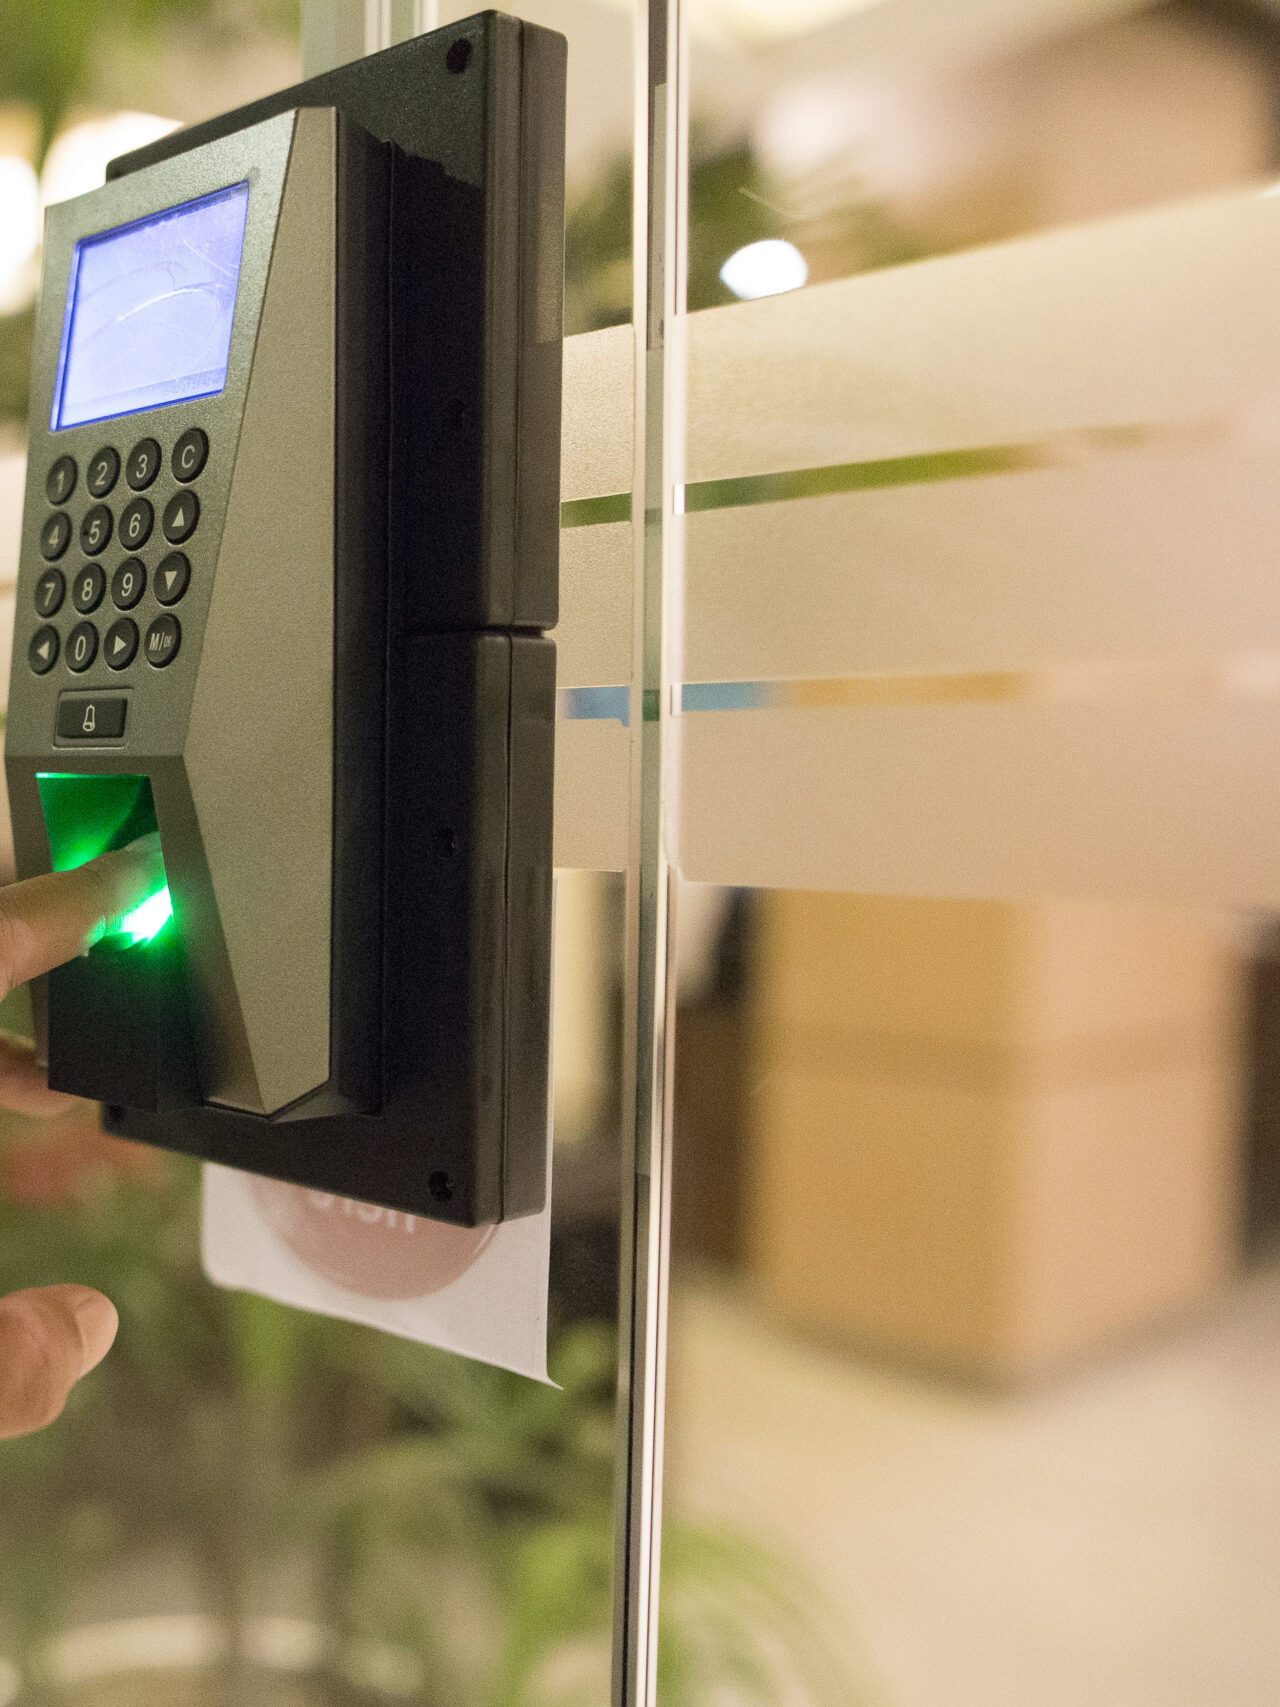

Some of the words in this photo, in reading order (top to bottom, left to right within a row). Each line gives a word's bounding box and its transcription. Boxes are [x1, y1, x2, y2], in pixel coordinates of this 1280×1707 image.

[135, 453, 148, 479] 3
[180, 444, 196, 470] C
[94, 461, 108, 487] 2
[47, 525, 60, 549] 4
[88, 519, 101, 545] 5
[128, 512, 142, 538] 6
[43, 582, 56, 607] 7
[81, 577, 94, 602] 8
[121, 572, 134, 598] 9
[74, 635, 87, 662] 0
